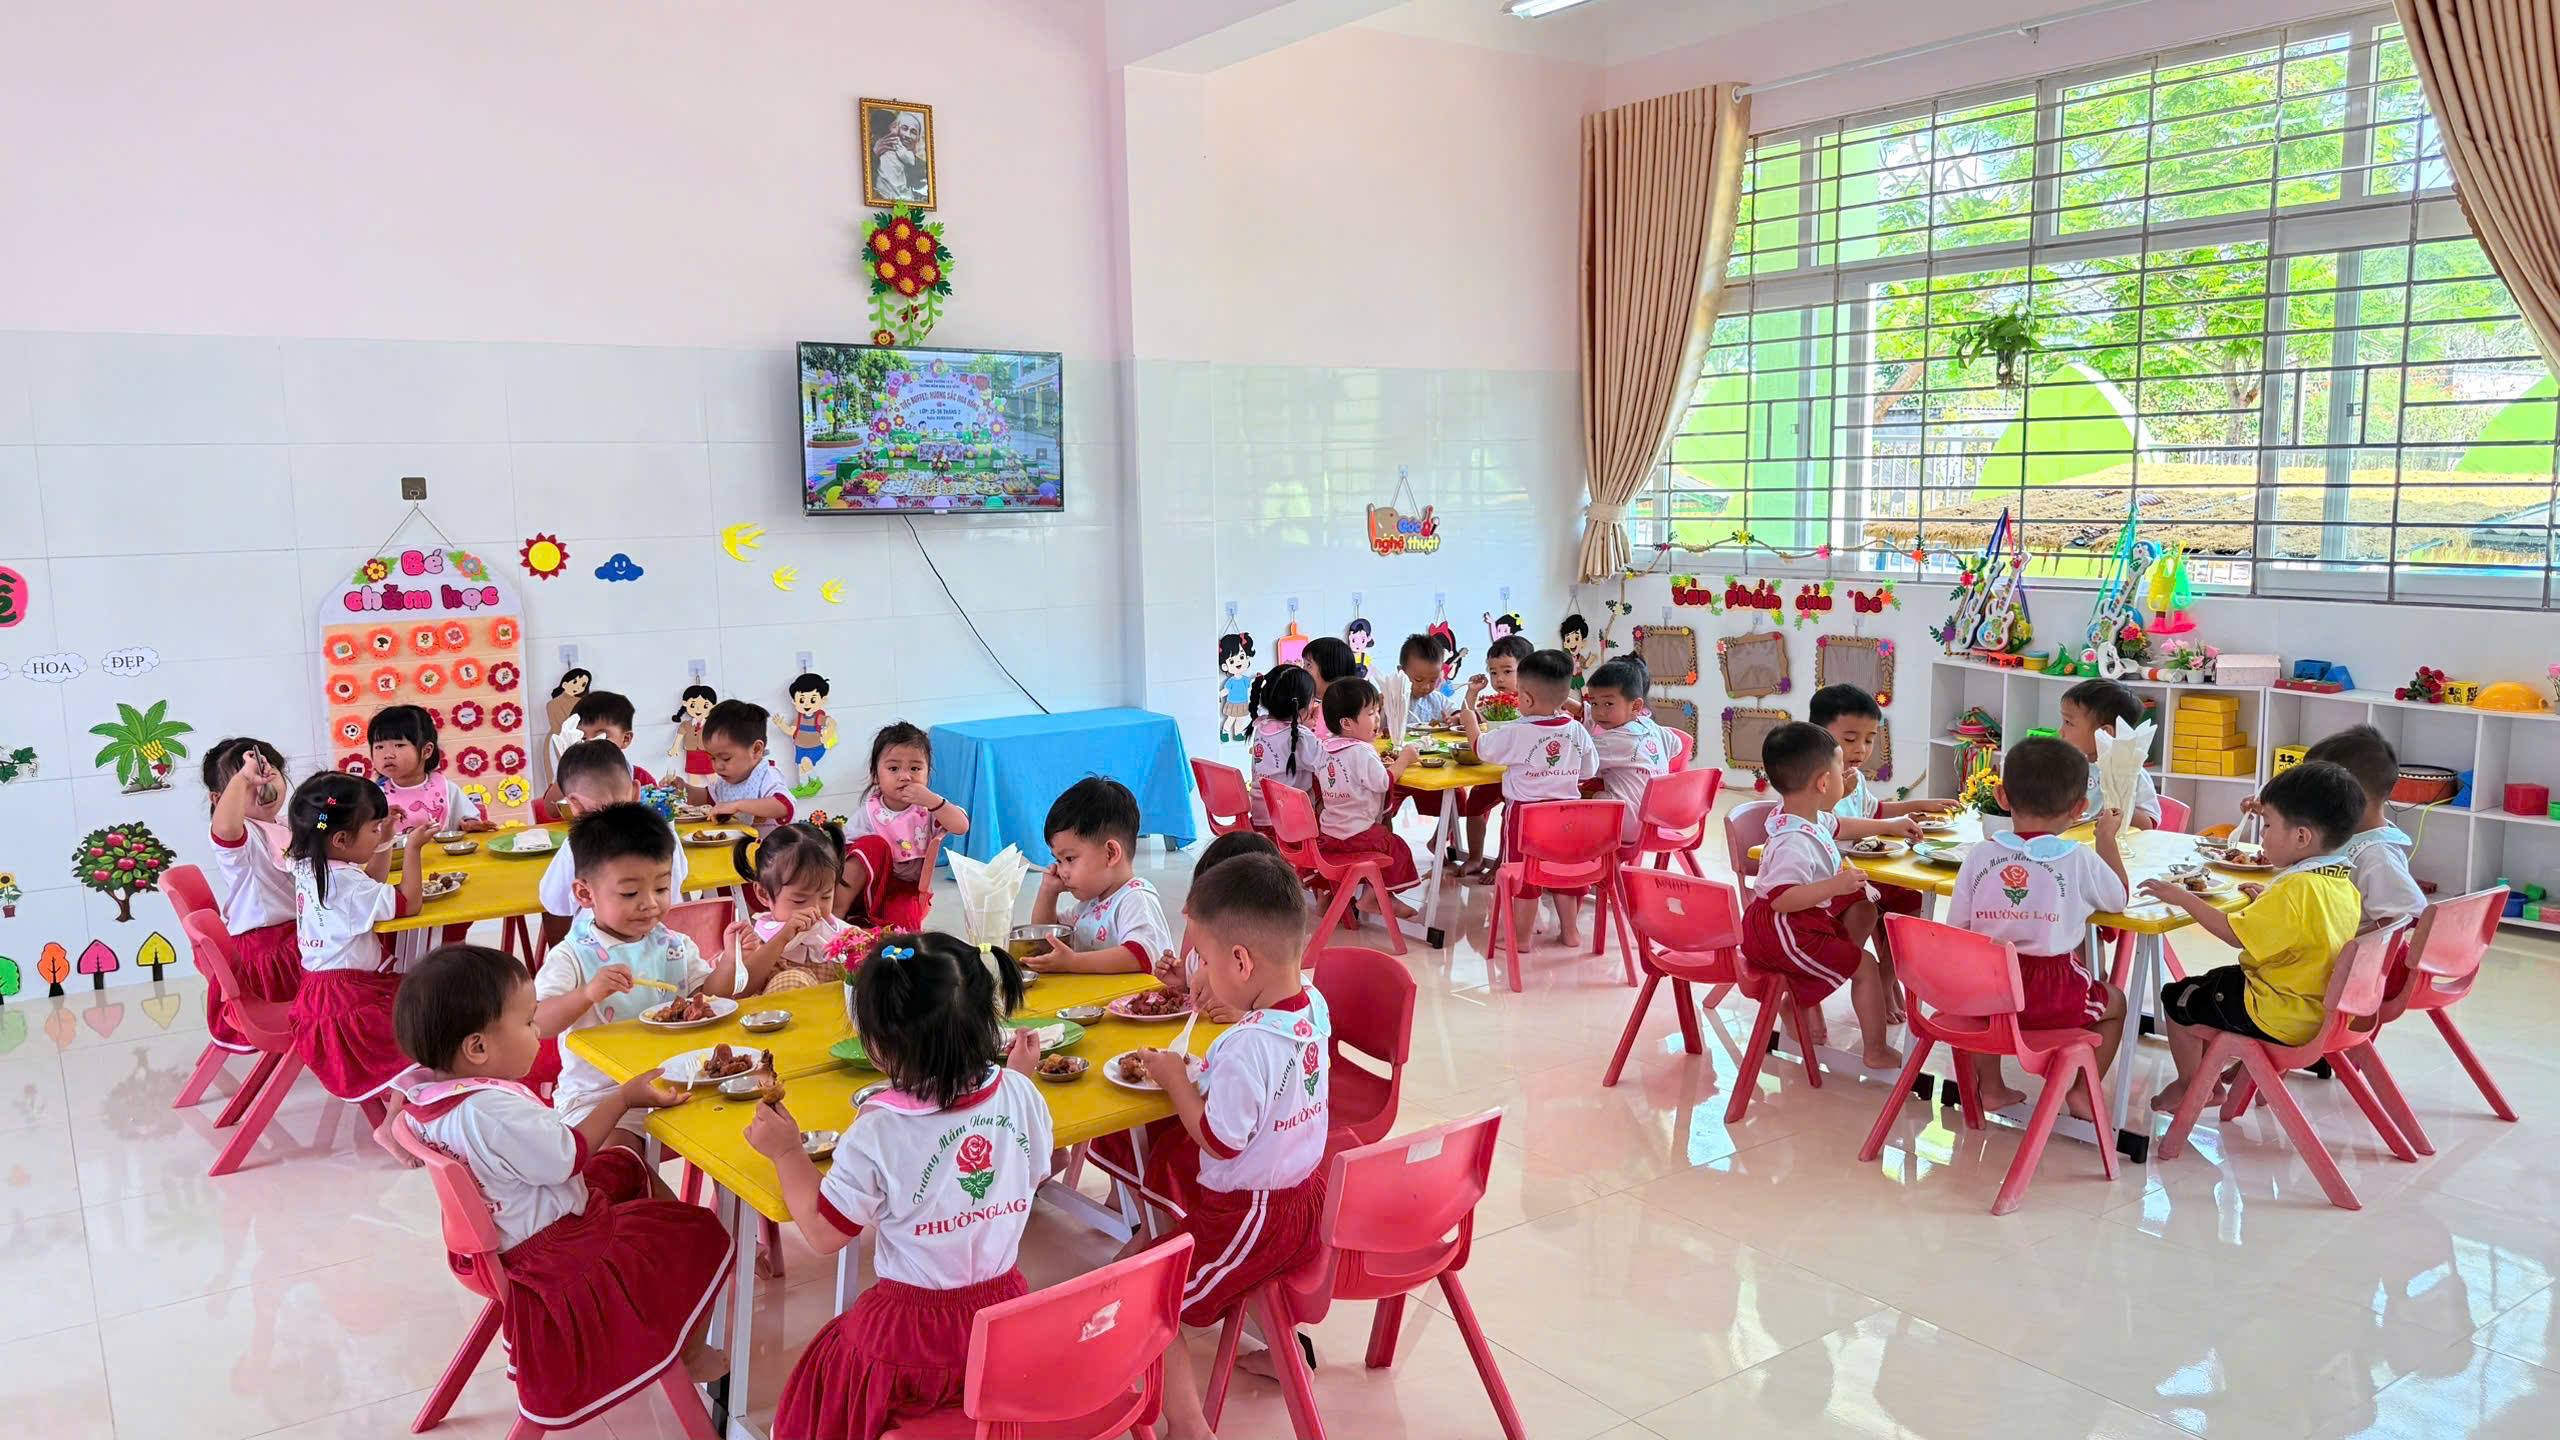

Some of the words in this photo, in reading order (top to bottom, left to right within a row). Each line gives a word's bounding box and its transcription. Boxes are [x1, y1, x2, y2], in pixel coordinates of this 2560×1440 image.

[401, 549, 444, 576] Bé
[33, 661, 72, 675] HOA
[112, 655, 145, 671] ĐẸP
[2279, 753, 2296, 764] 12
[1976, 909, 2029, 920] PHƯỜNG
[2033, 911, 2060, 922] LAGI
[1273, 1101, 1322, 1132] PHƯỜNG
[912, 1153, 940, 1205] Trường
[914, 1205, 996, 1236] PHƯỜNG
[995, 1198, 1027, 1216] LAG
